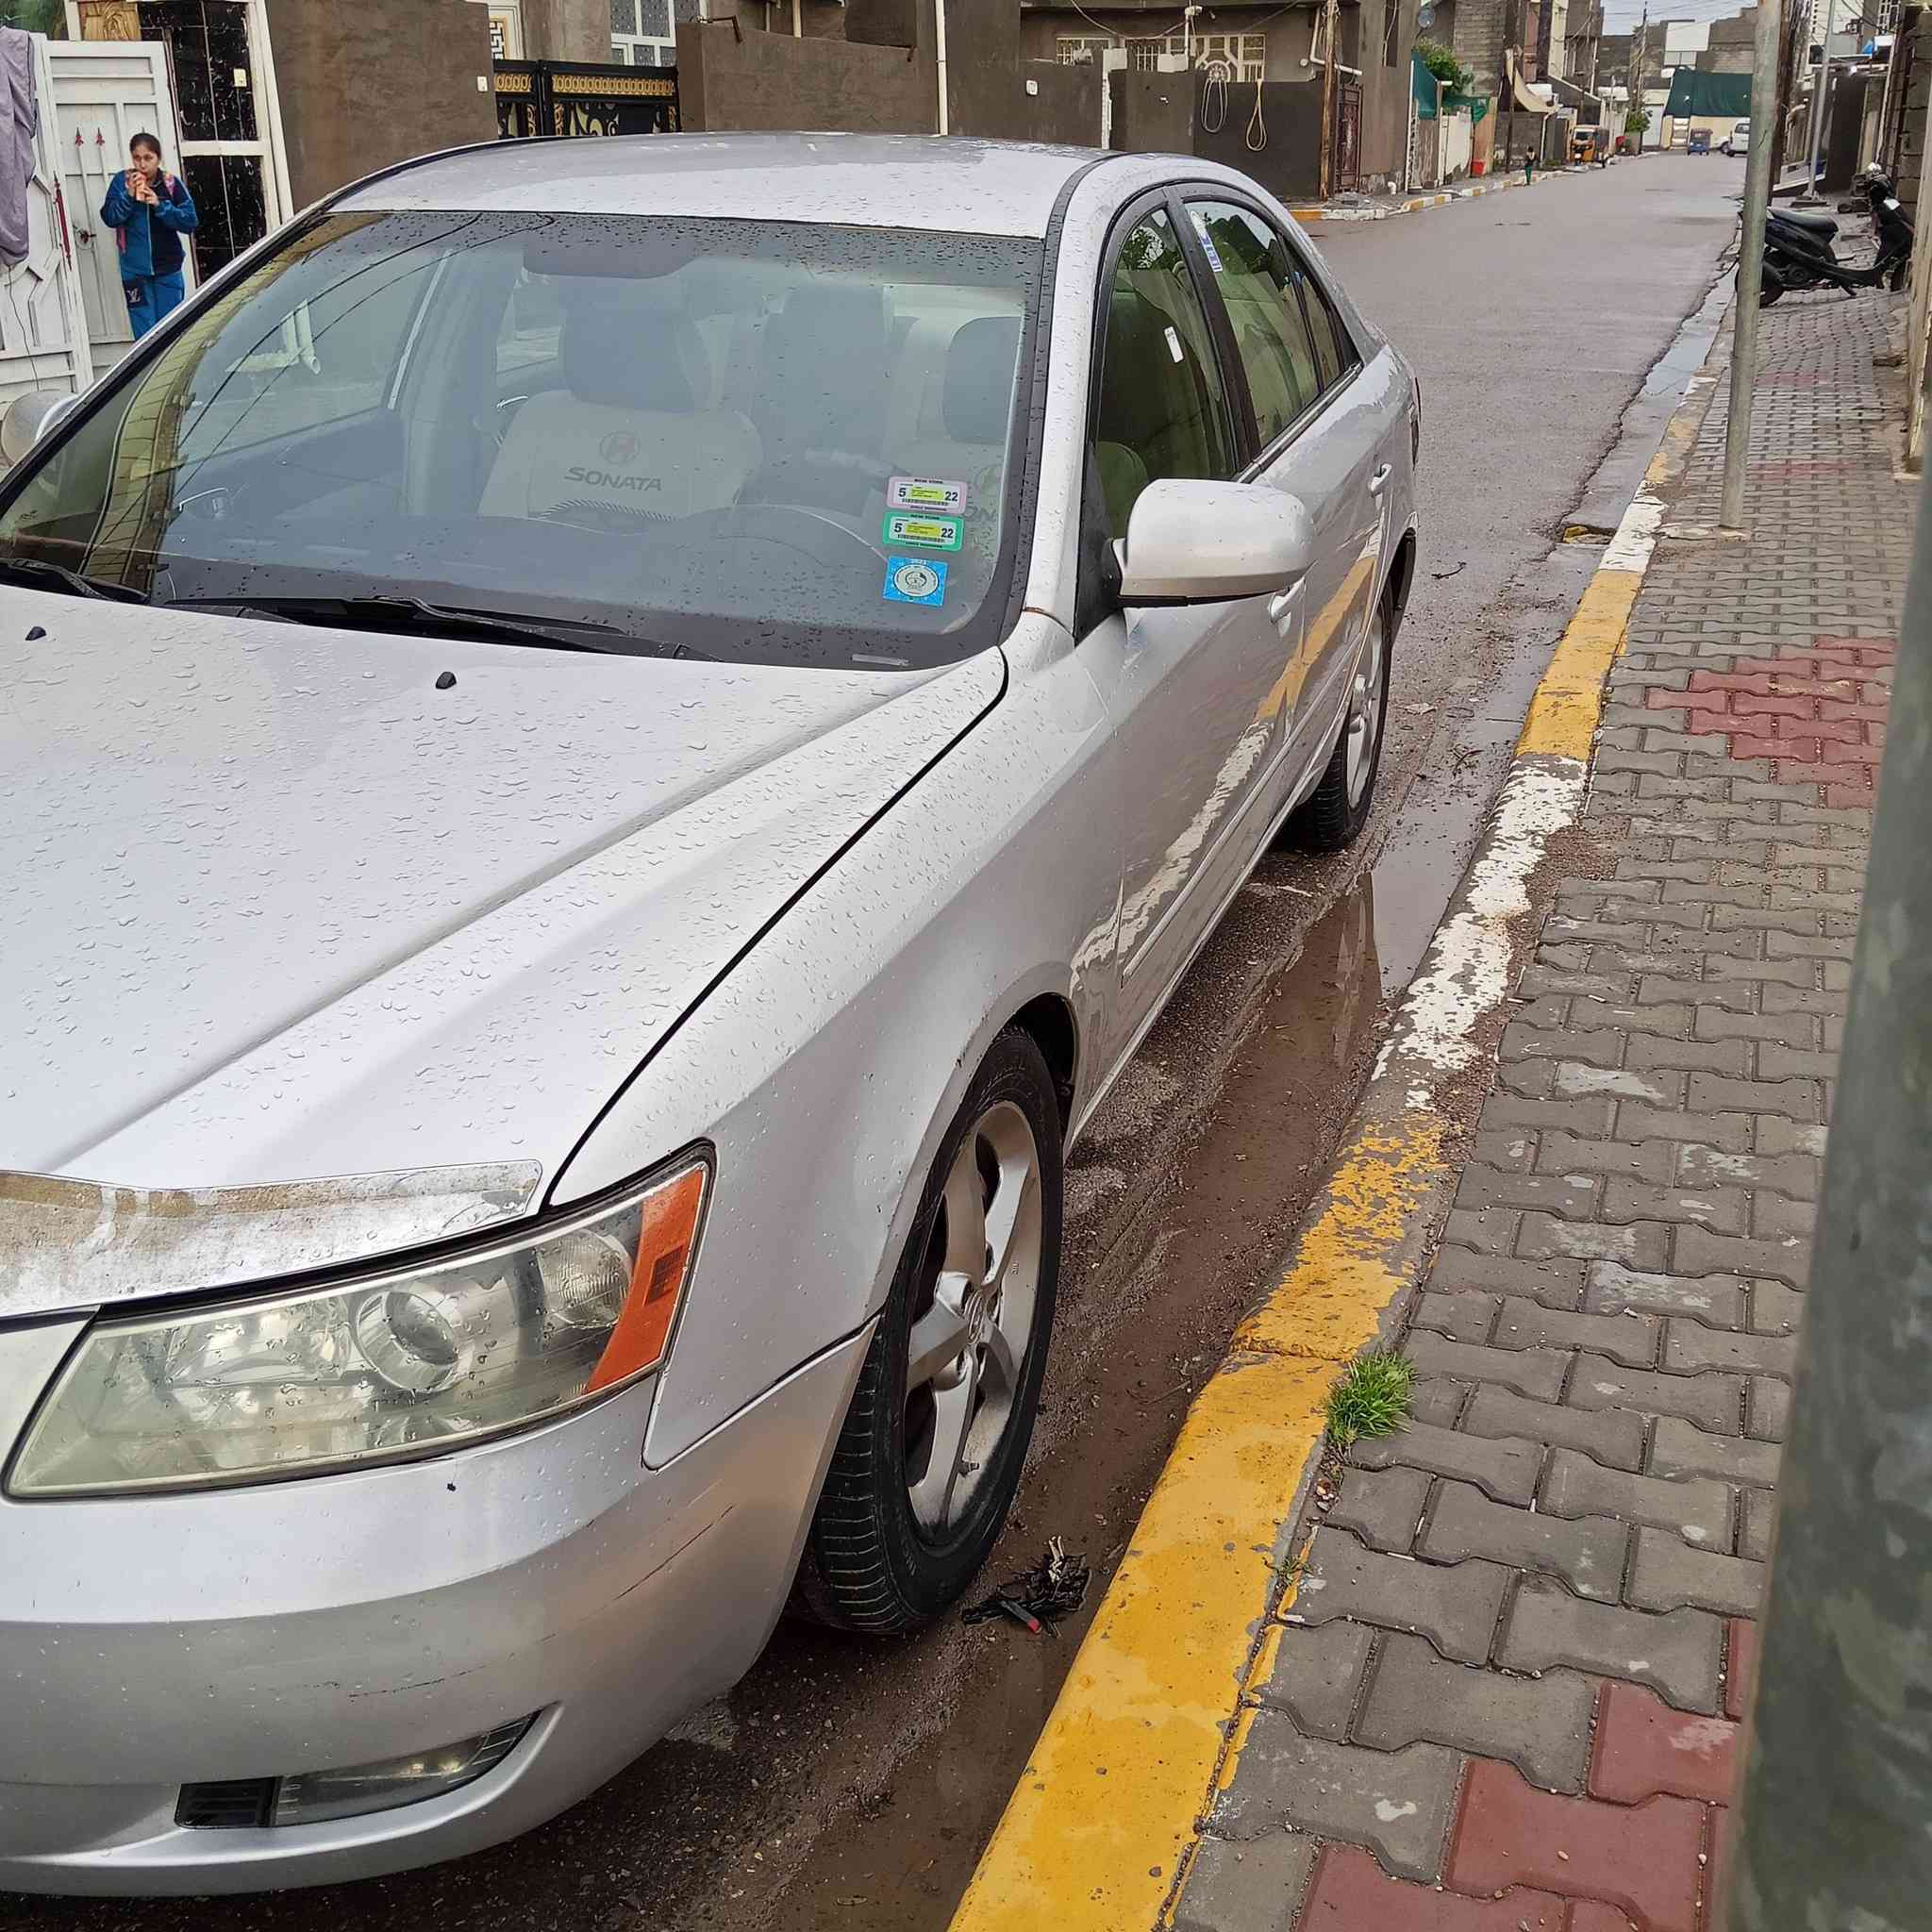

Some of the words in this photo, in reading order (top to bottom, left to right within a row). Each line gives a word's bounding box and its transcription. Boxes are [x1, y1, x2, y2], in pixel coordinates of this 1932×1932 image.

[564, 466, 662, 491] SONATA
[898, 487, 907, 497] 5
[944, 491, 958, 502] 22
[894, 523, 903, 533] 5
[941, 527, 955, 539] 22
